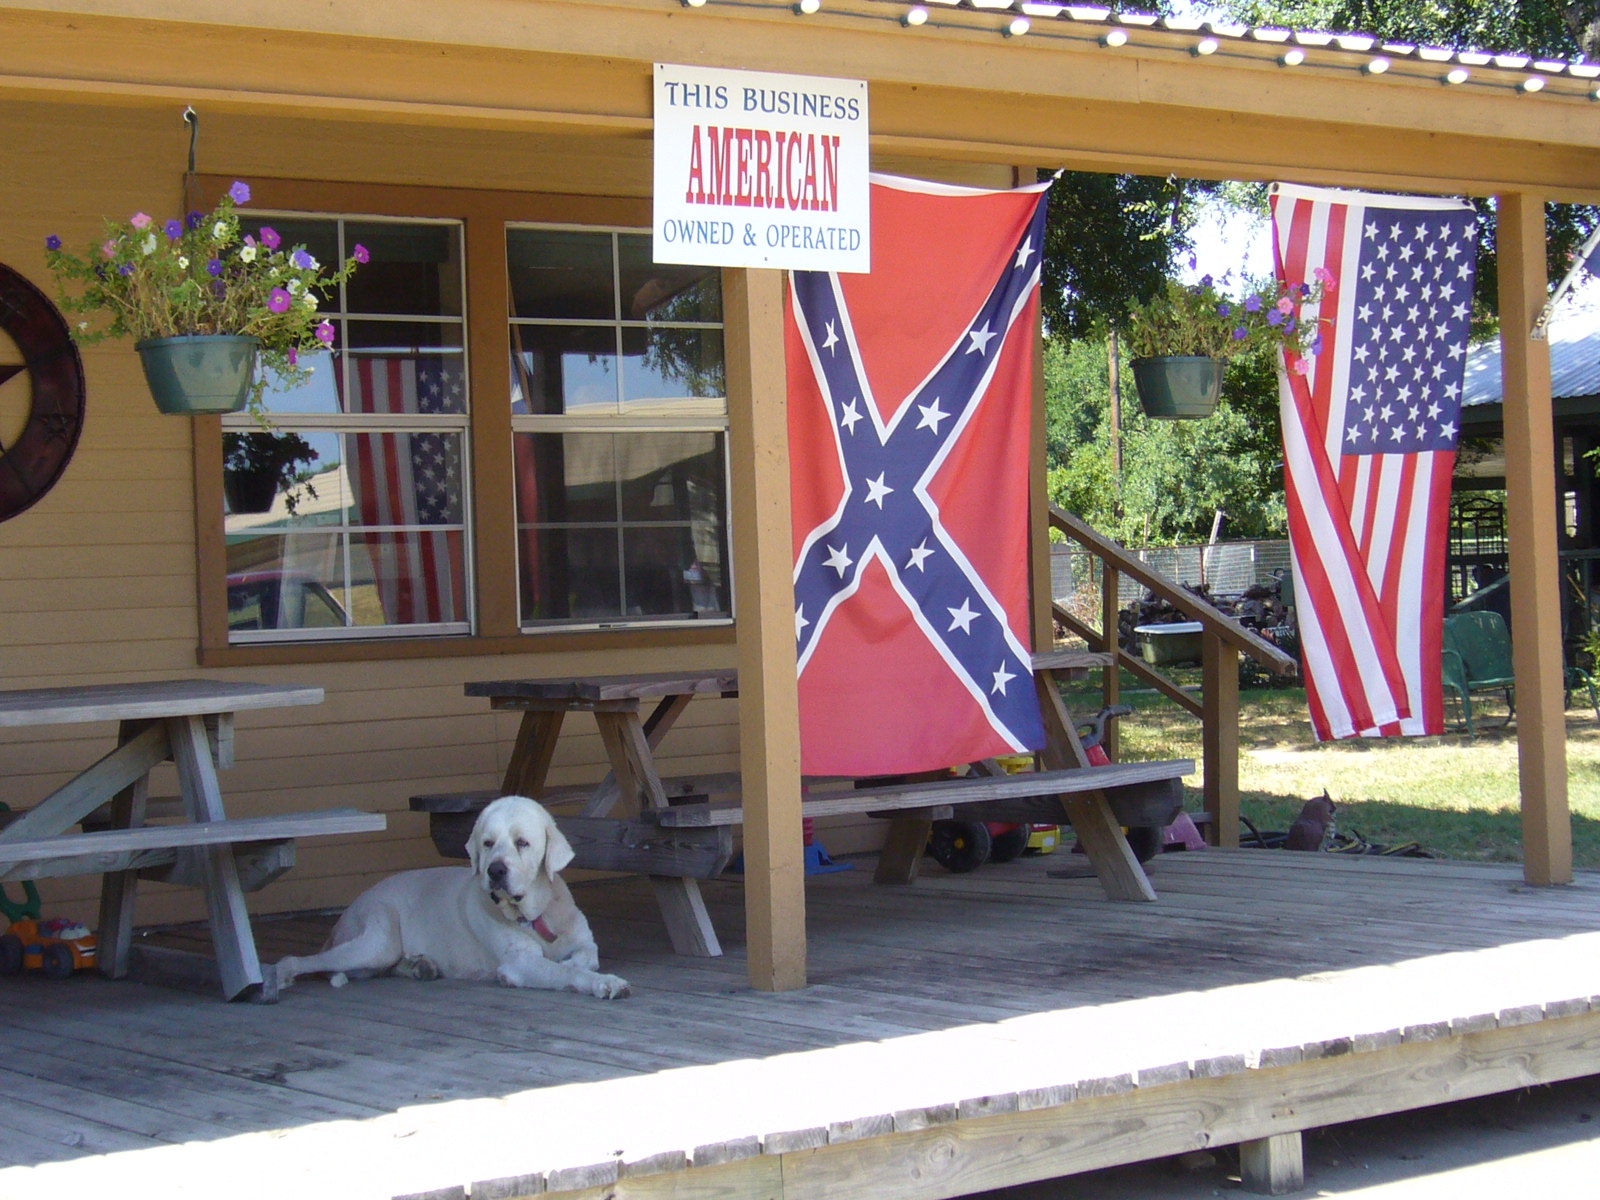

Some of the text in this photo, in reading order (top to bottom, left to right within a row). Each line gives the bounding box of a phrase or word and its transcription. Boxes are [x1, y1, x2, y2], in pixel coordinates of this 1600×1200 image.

[664, 81, 860, 121] THIS BUSINESS
[686, 124, 840, 213] AMERICAN
[663, 219, 861, 252] OWNED & OPERATED
